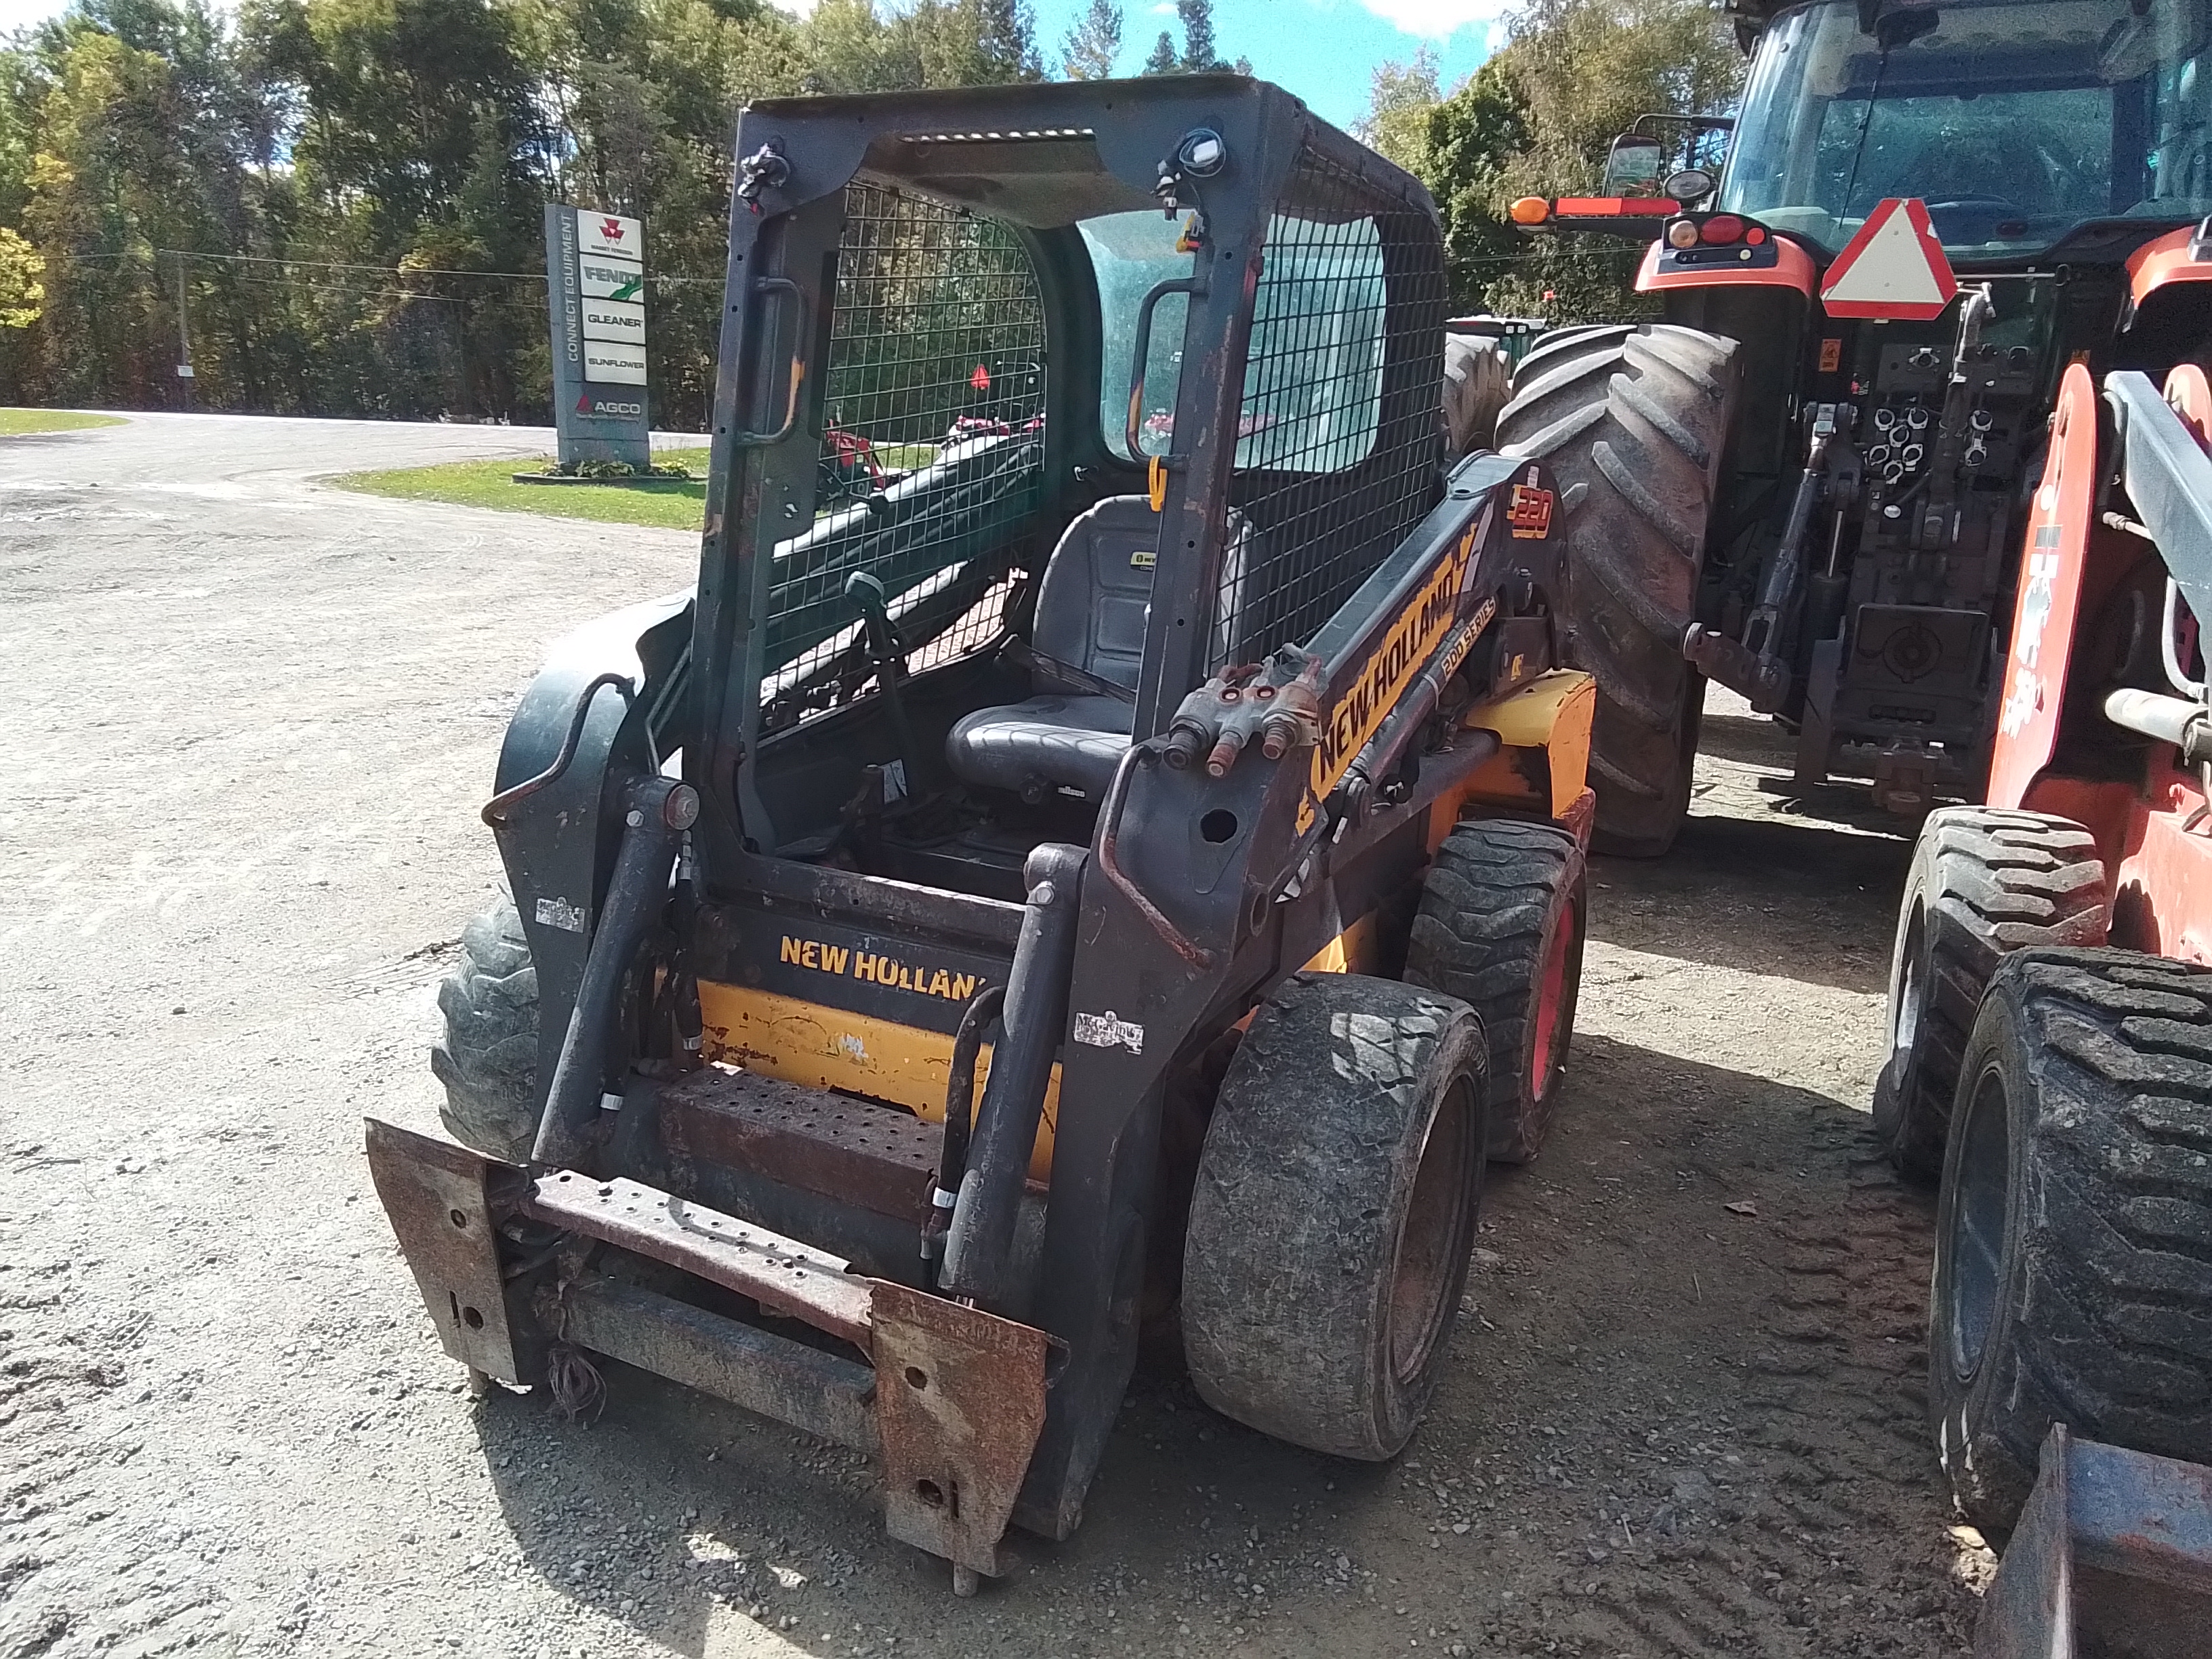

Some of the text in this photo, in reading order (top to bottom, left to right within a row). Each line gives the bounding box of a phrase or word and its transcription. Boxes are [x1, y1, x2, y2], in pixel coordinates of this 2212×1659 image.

[561, 214, 579, 363] CONNECT EQUIPMENT
[588, 314, 641, 328] GLEANER
[588, 358, 644, 369] SUNFLOWER
[594, 401, 641, 414] AGCO
[1442, 598, 1496, 677] 200 SERIES
[1317, 571, 1454, 785] NEW HOLLAND
[780, 935, 987, 1002] NEW HOLLAN
